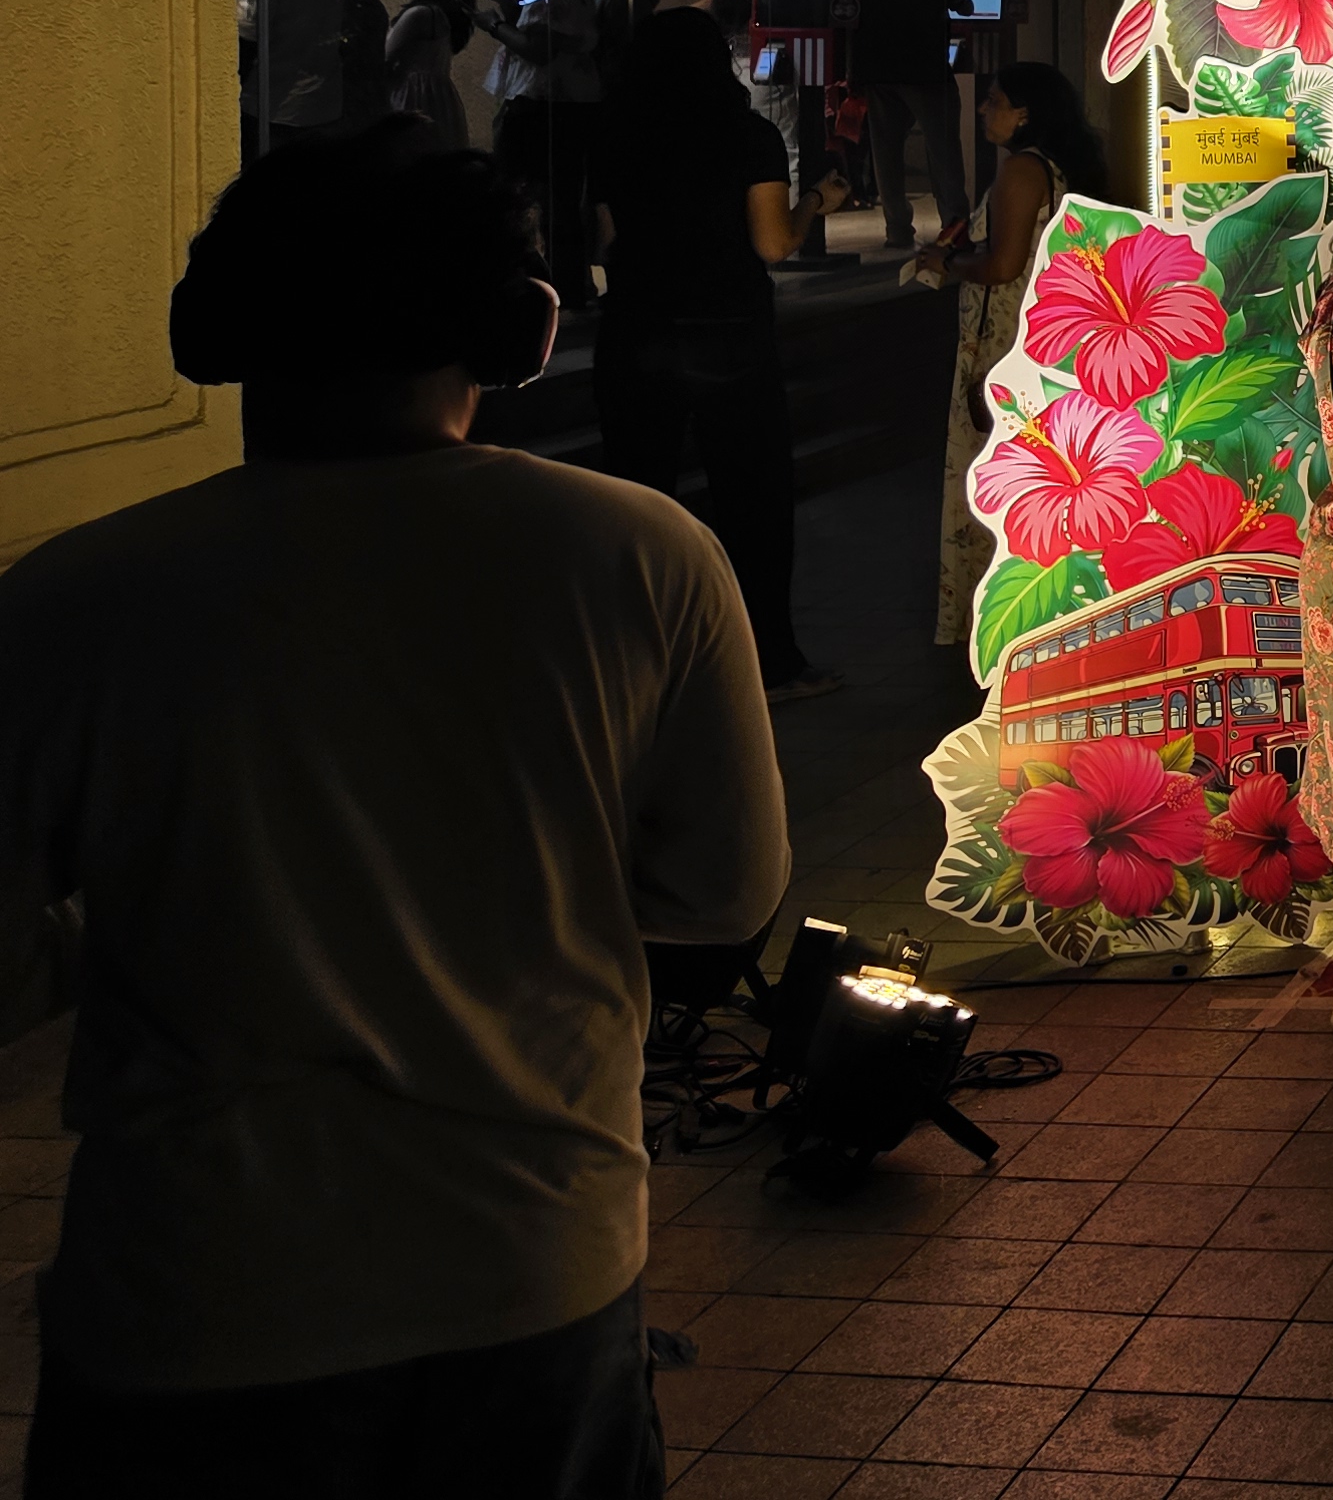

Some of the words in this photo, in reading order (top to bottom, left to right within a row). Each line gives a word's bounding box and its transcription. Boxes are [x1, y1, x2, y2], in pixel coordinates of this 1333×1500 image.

[1195, 127, 1225, 149] मुंबई
[1231, 126, 1260, 148] मुंबई
[1201, 152, 1257, 165] MUMBAI
